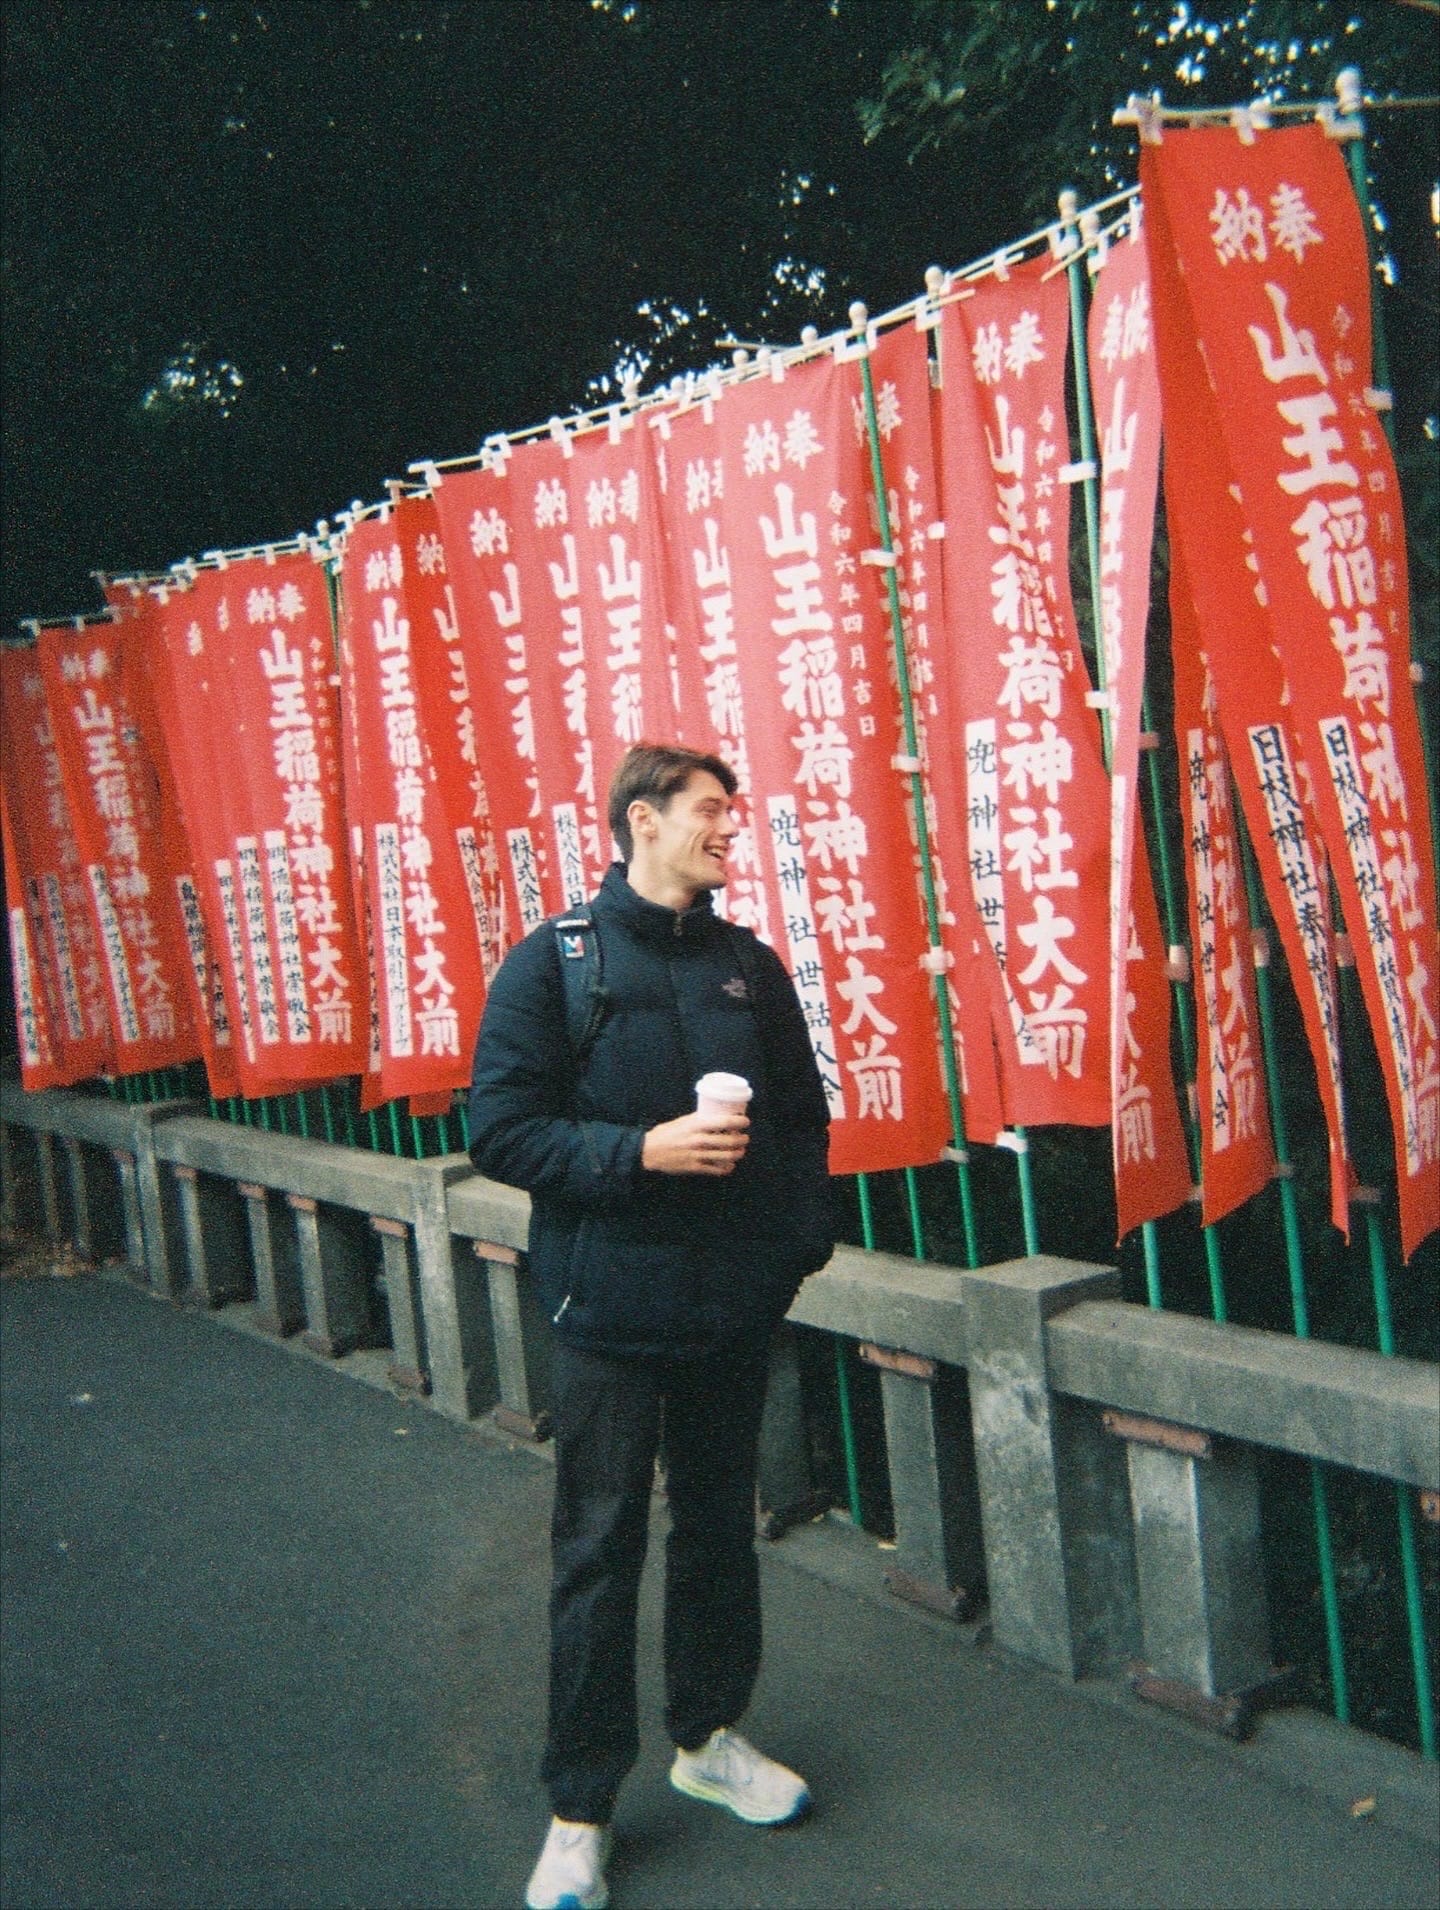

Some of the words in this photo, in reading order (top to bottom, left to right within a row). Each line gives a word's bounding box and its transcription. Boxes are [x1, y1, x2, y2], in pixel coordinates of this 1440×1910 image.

[973, 311, 1046, 386] 奉納
[1208, 181, 1326, 267] 奉納
[743, 409, 824, 478] 奉納
[828, 489, 877, 737] 令和六年四月吉日
[984, 394, 1089, 1081] 山王稲荷神社大前
[258, 628, 353, 1045] 山王稲荷神社大前
[370, 597, 461, 1057] 山王稲荷神社大前
[758, 483, 903, 1121] 山王稲荷神社大前
